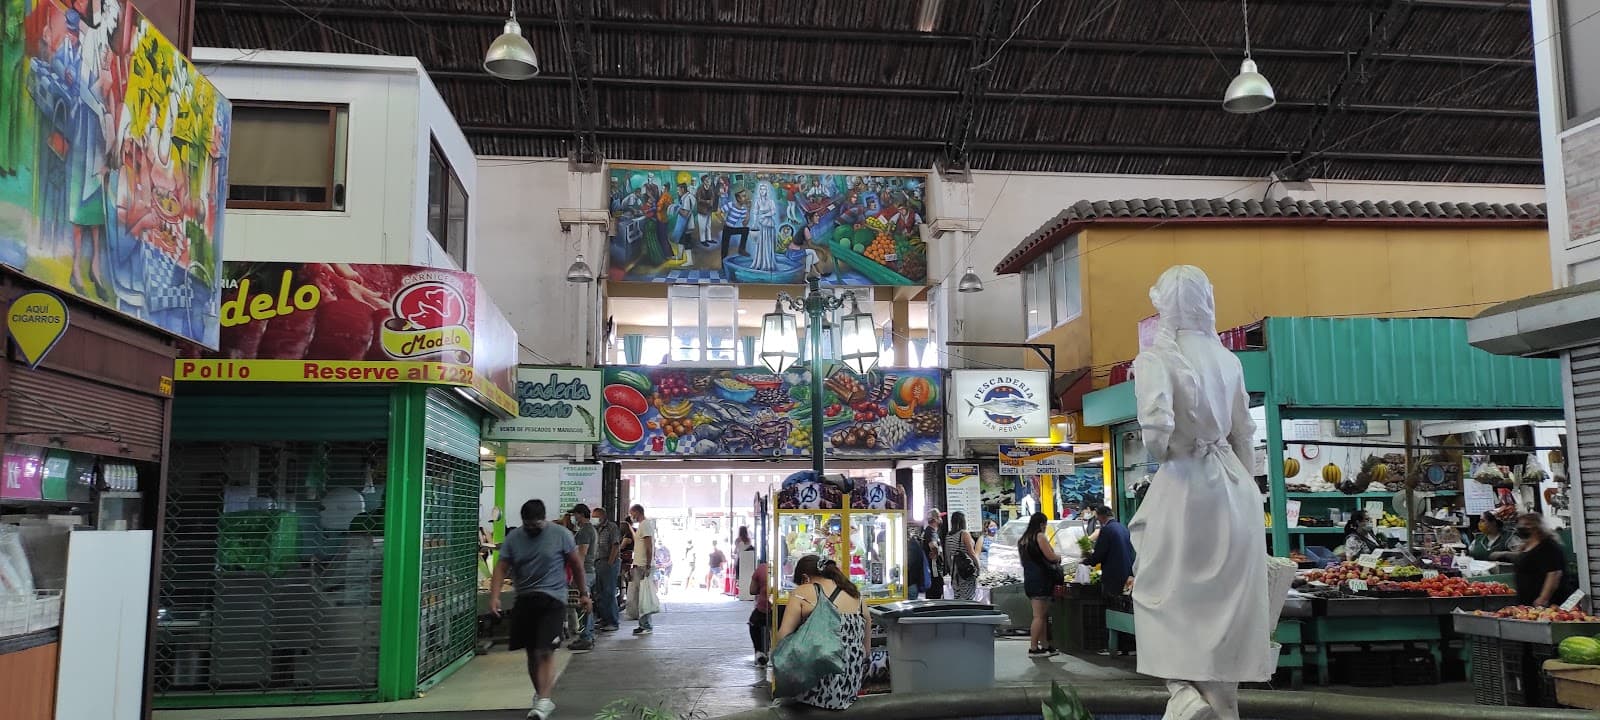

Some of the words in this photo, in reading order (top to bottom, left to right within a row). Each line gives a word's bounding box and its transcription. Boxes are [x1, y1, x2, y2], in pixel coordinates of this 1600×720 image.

[220, 269, 321, 327] delo
[12, 314, 61, 324] CIGARROS
[401, 331, 461, 356] Modelo
[303, 362, 400, 380] Reserve
[407, 364, 430, 381] al
[974, 376, 1034, 400] PESCADERIA
[982, 419, 997, 431] SAN
[998, 422, 1022, 433] PEDRO
